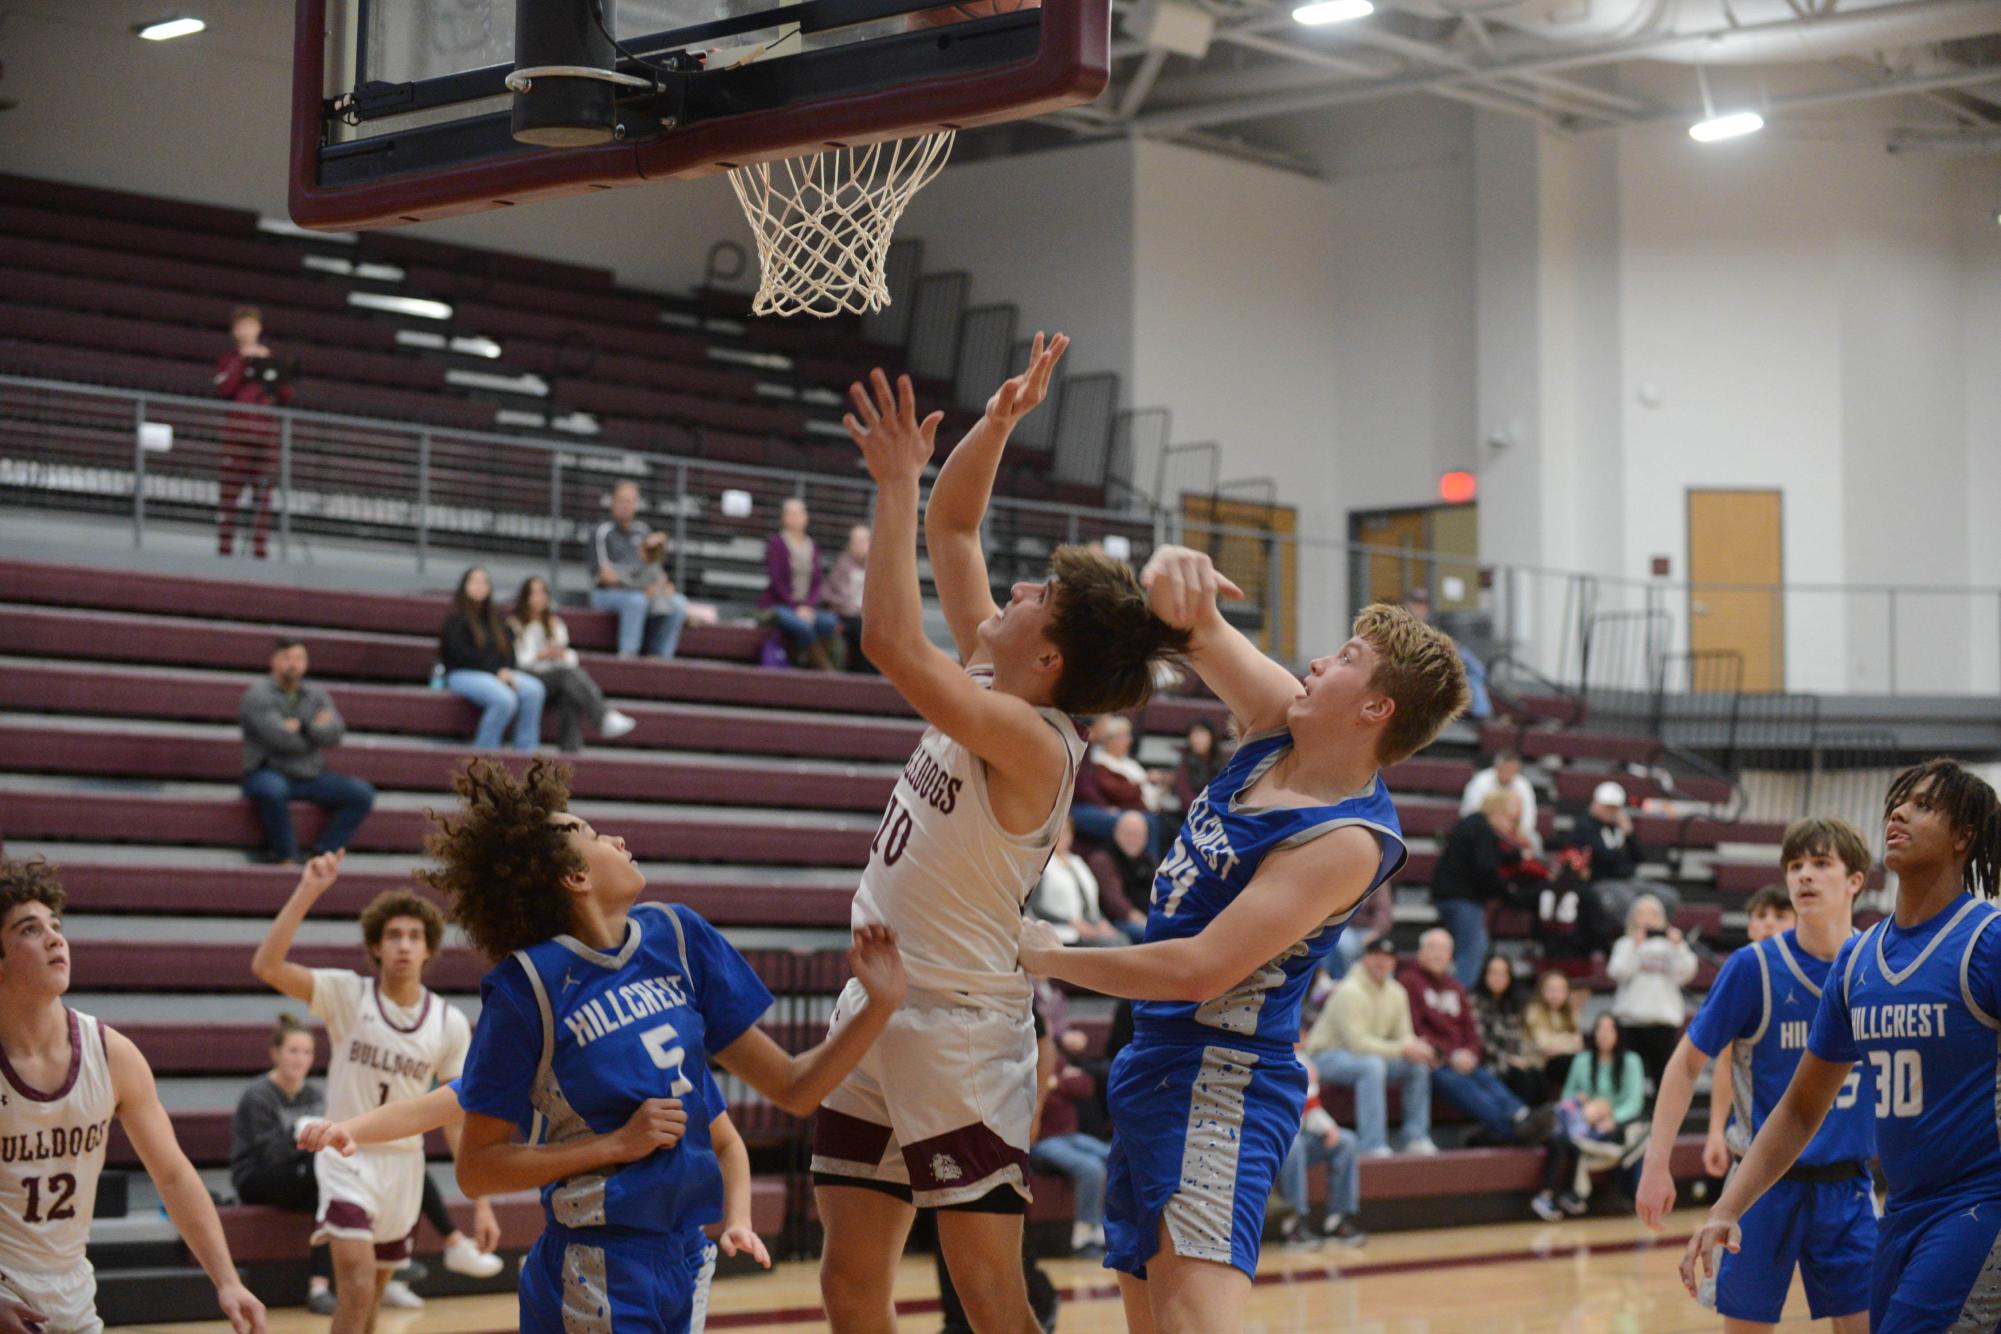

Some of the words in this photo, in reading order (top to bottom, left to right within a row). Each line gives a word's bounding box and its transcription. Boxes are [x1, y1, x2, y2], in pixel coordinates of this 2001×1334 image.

[872, 794, 913, 867] 10
[639, 1022, 694, 1098] 5
[1830, 1060, 1863, 1109] 5
[1868, 1049, 1924, 1118] 30
[379, 1082, 390, 1107] 1
[21, 1172, 77, 1223] 12
